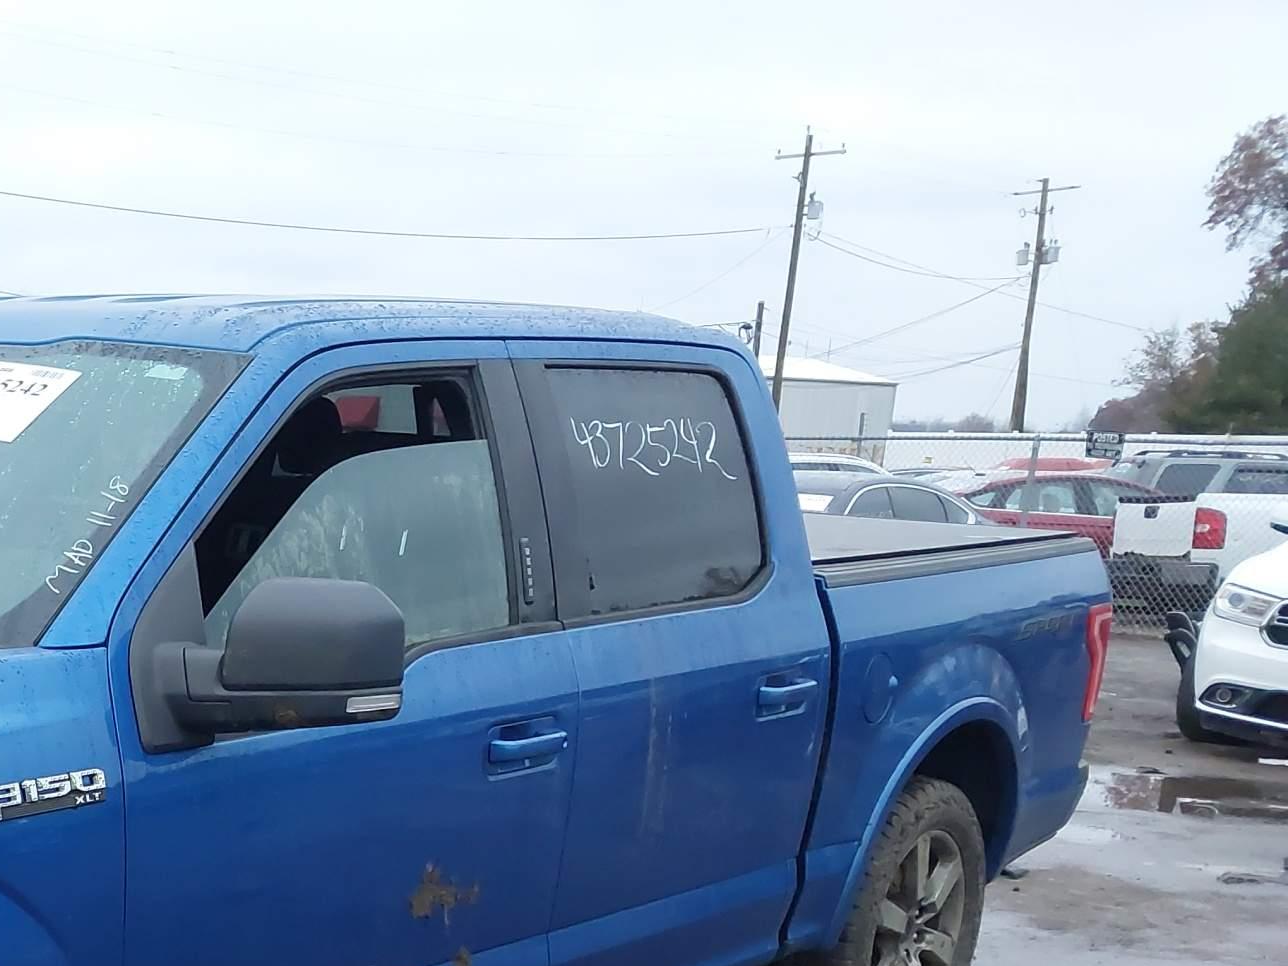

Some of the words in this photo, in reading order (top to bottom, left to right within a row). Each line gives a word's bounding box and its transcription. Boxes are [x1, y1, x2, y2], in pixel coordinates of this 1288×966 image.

[570, 416, 738, 480] 43725242
[45, 539, 93, 594] MAD
[85, 475, 129, 527] 11-18
[75, 792, 102, 805] XLT
